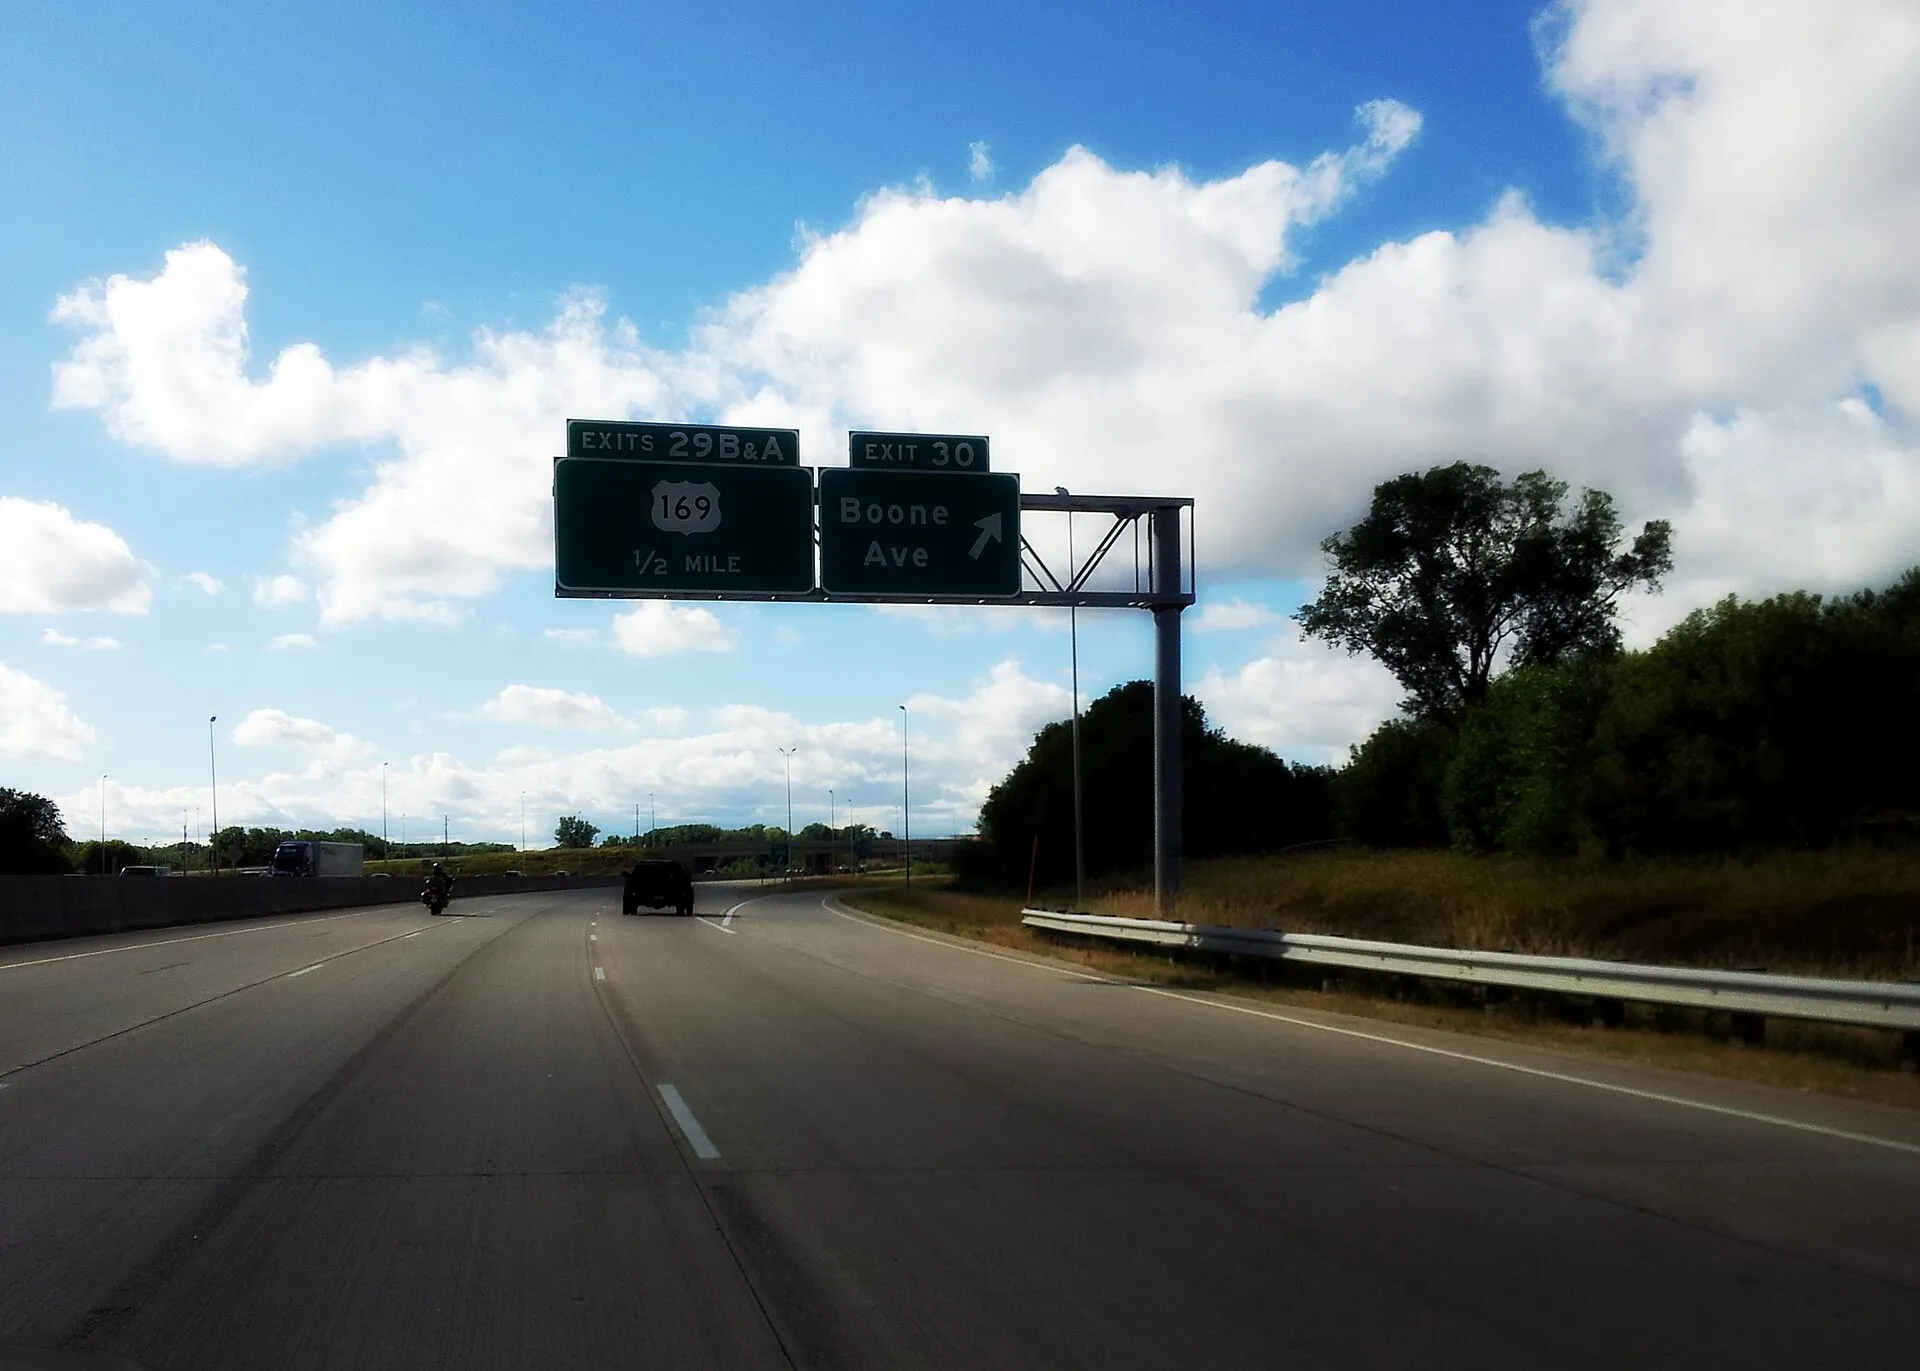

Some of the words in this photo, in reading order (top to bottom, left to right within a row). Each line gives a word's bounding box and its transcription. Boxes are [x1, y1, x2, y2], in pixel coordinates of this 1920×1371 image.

[582, 432, 655, 452] EXITS
[668, 431, 784, 461] 29B&A
[865, 443, 918, 461] EXIT
[931, 441, 974, 467] 30
[660, 494, 711, 520] 169
[840, 498, 949, 524] Boone
[632, 549, 668, 576] 1/2
[685, 555, 741, 574] MILE
[863, 541, 929, 568] Ave
